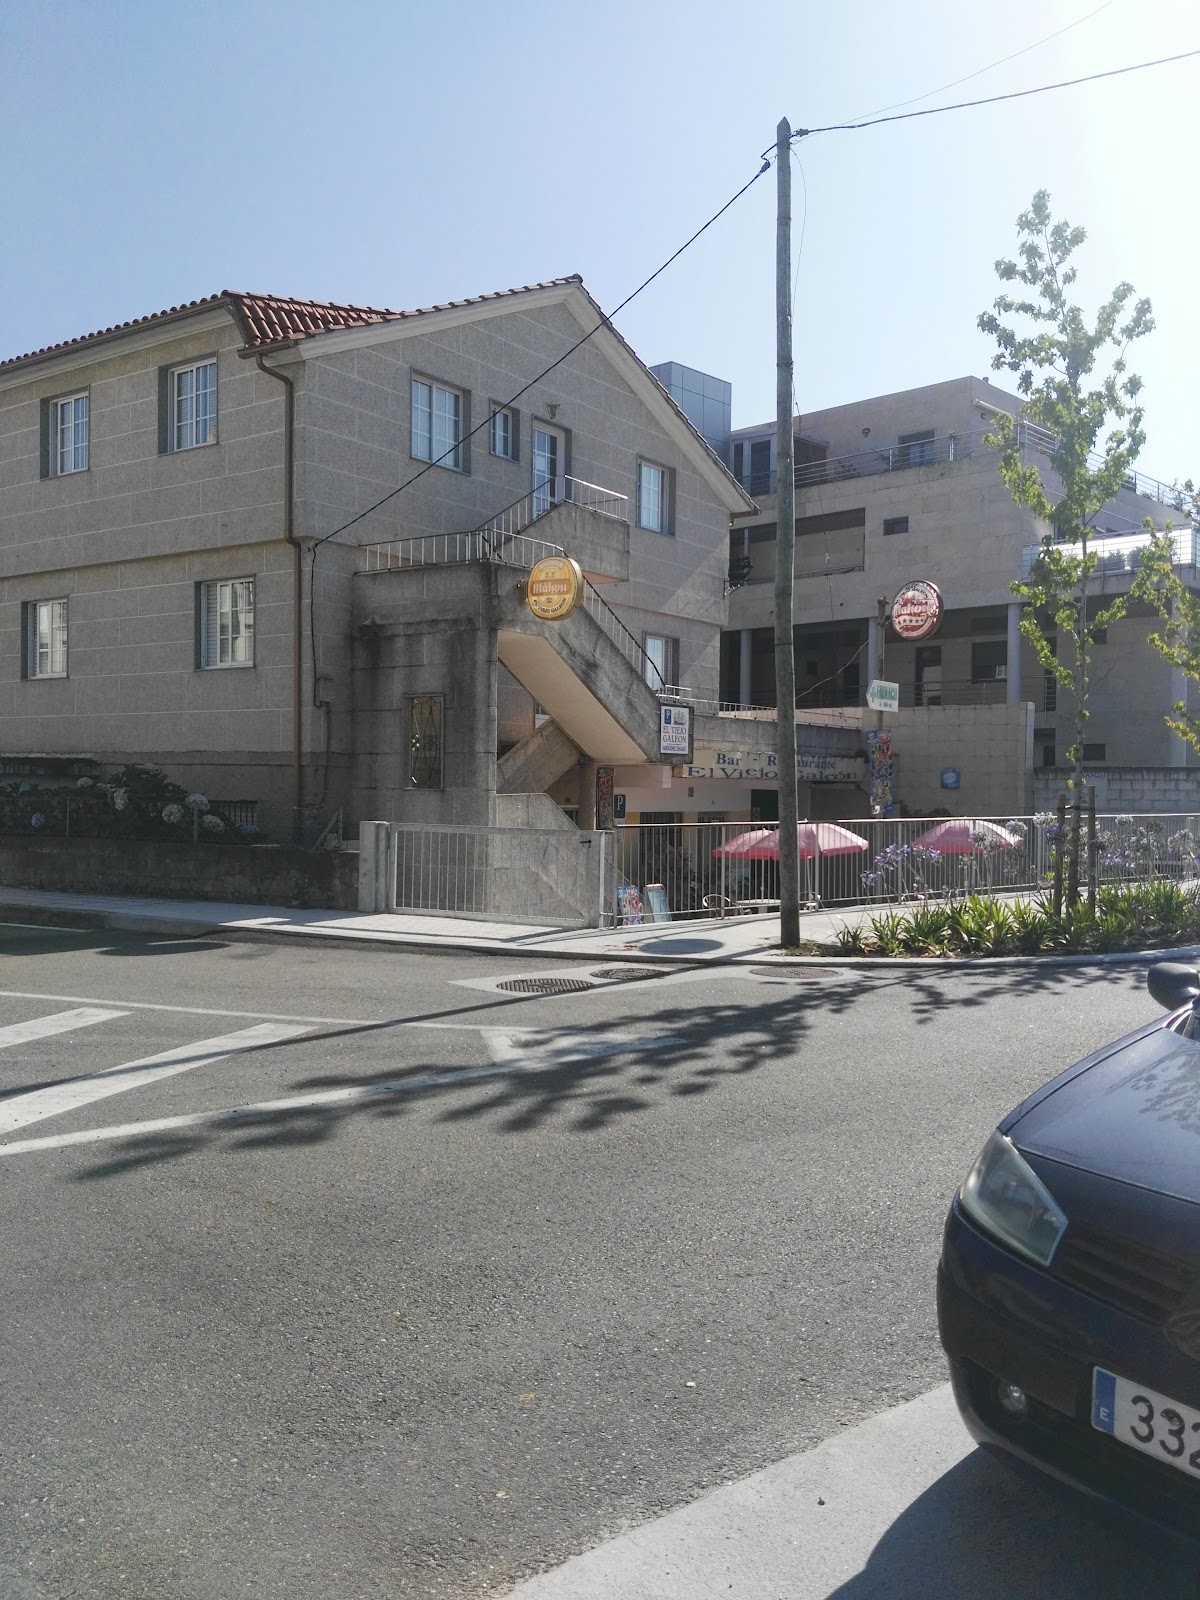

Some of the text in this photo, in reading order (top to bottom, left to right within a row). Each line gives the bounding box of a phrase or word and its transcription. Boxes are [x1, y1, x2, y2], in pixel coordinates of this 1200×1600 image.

[663, 725, 687, 736] EL VIEJO
[716, 752, 741, 766] Bar
[686, 765, 714, 778] El
[719, 767, 779, 779] Viejo
[616, 795, 624, 811] P
